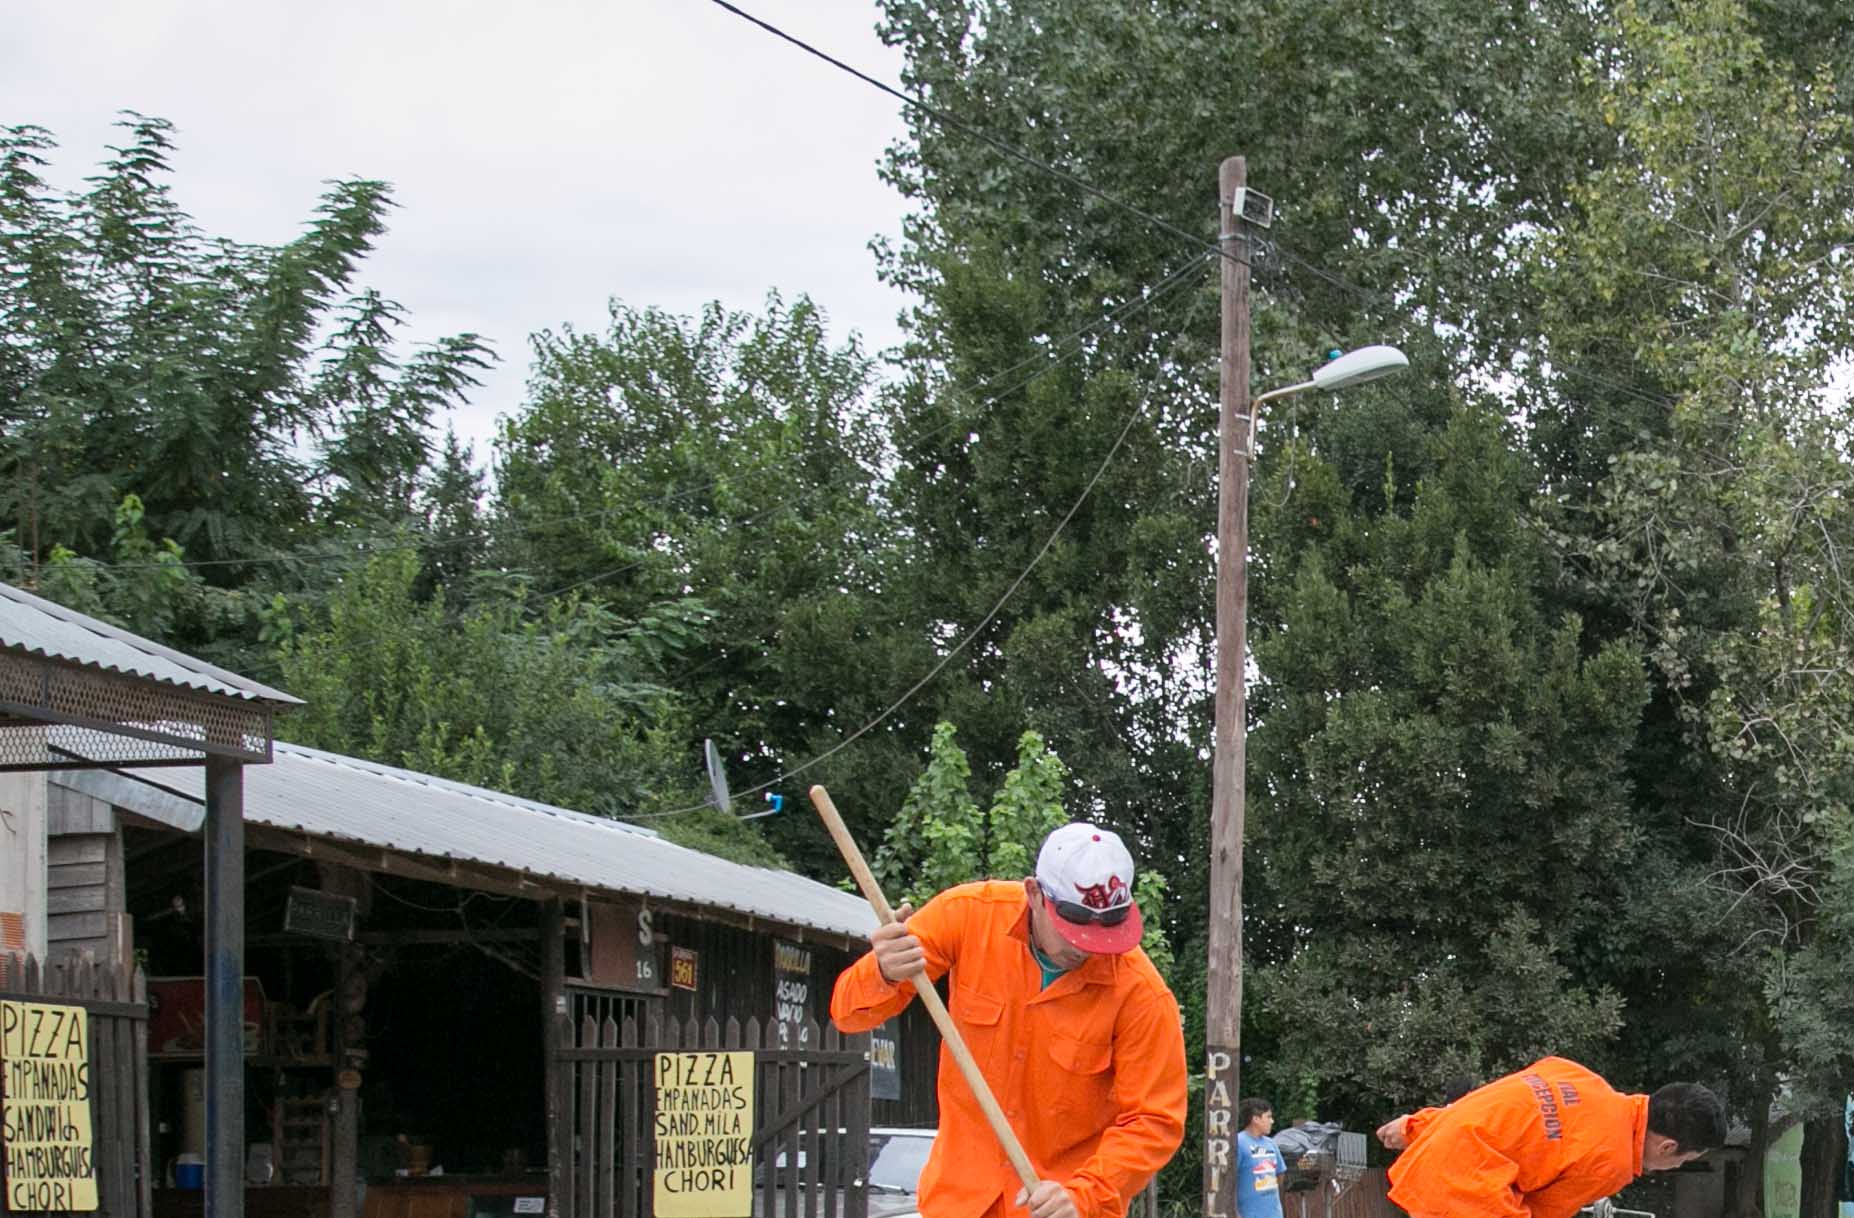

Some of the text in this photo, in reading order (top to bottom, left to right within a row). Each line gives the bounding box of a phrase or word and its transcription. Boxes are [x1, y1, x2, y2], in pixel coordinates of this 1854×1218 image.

[636, 961, 653, 978] 16
[776, 979, 808, 1003] ASADO
[3, 1002, 84, 1060] PIZZA
[2, 1059, 89, 1101] EMPANADAS
[660, 1053, 735, 1086] PIZZA
[656, 1086, 747, 1111] EMPANADAS
[6, 1144, 95, 1179] HAMBURGUES
[14, 1180, 75, 1211] CHORI
[664, 1167, 735, 1194] CHORI
